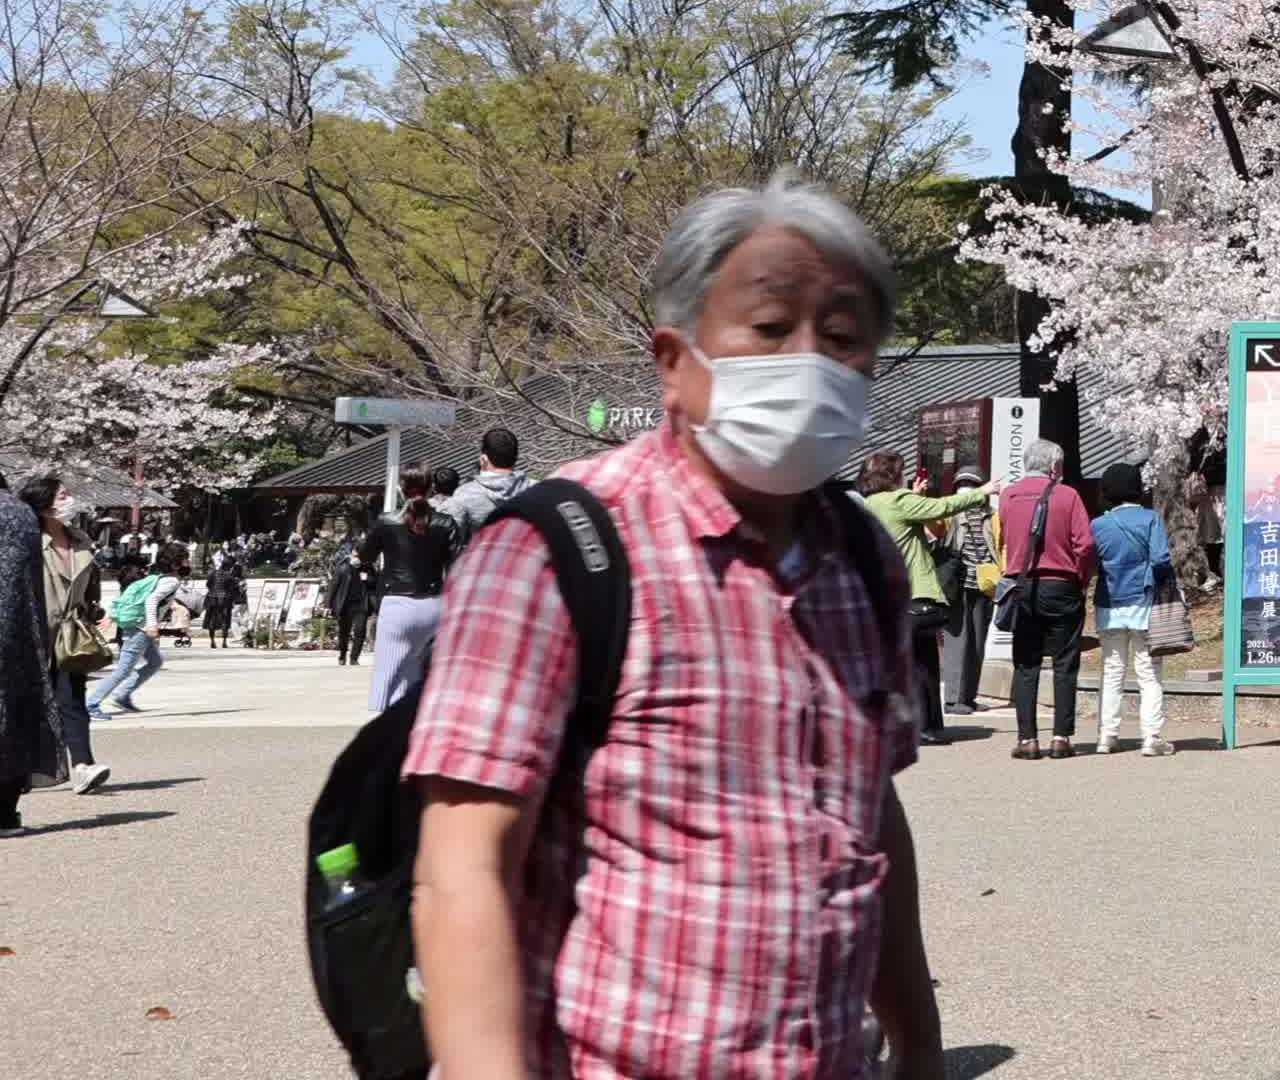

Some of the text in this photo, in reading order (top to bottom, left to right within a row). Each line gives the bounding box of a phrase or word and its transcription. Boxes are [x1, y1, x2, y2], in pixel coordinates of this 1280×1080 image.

[608, 406, 657, 428] PARK
[1258, 520, 1280, 618] 吉田博展
